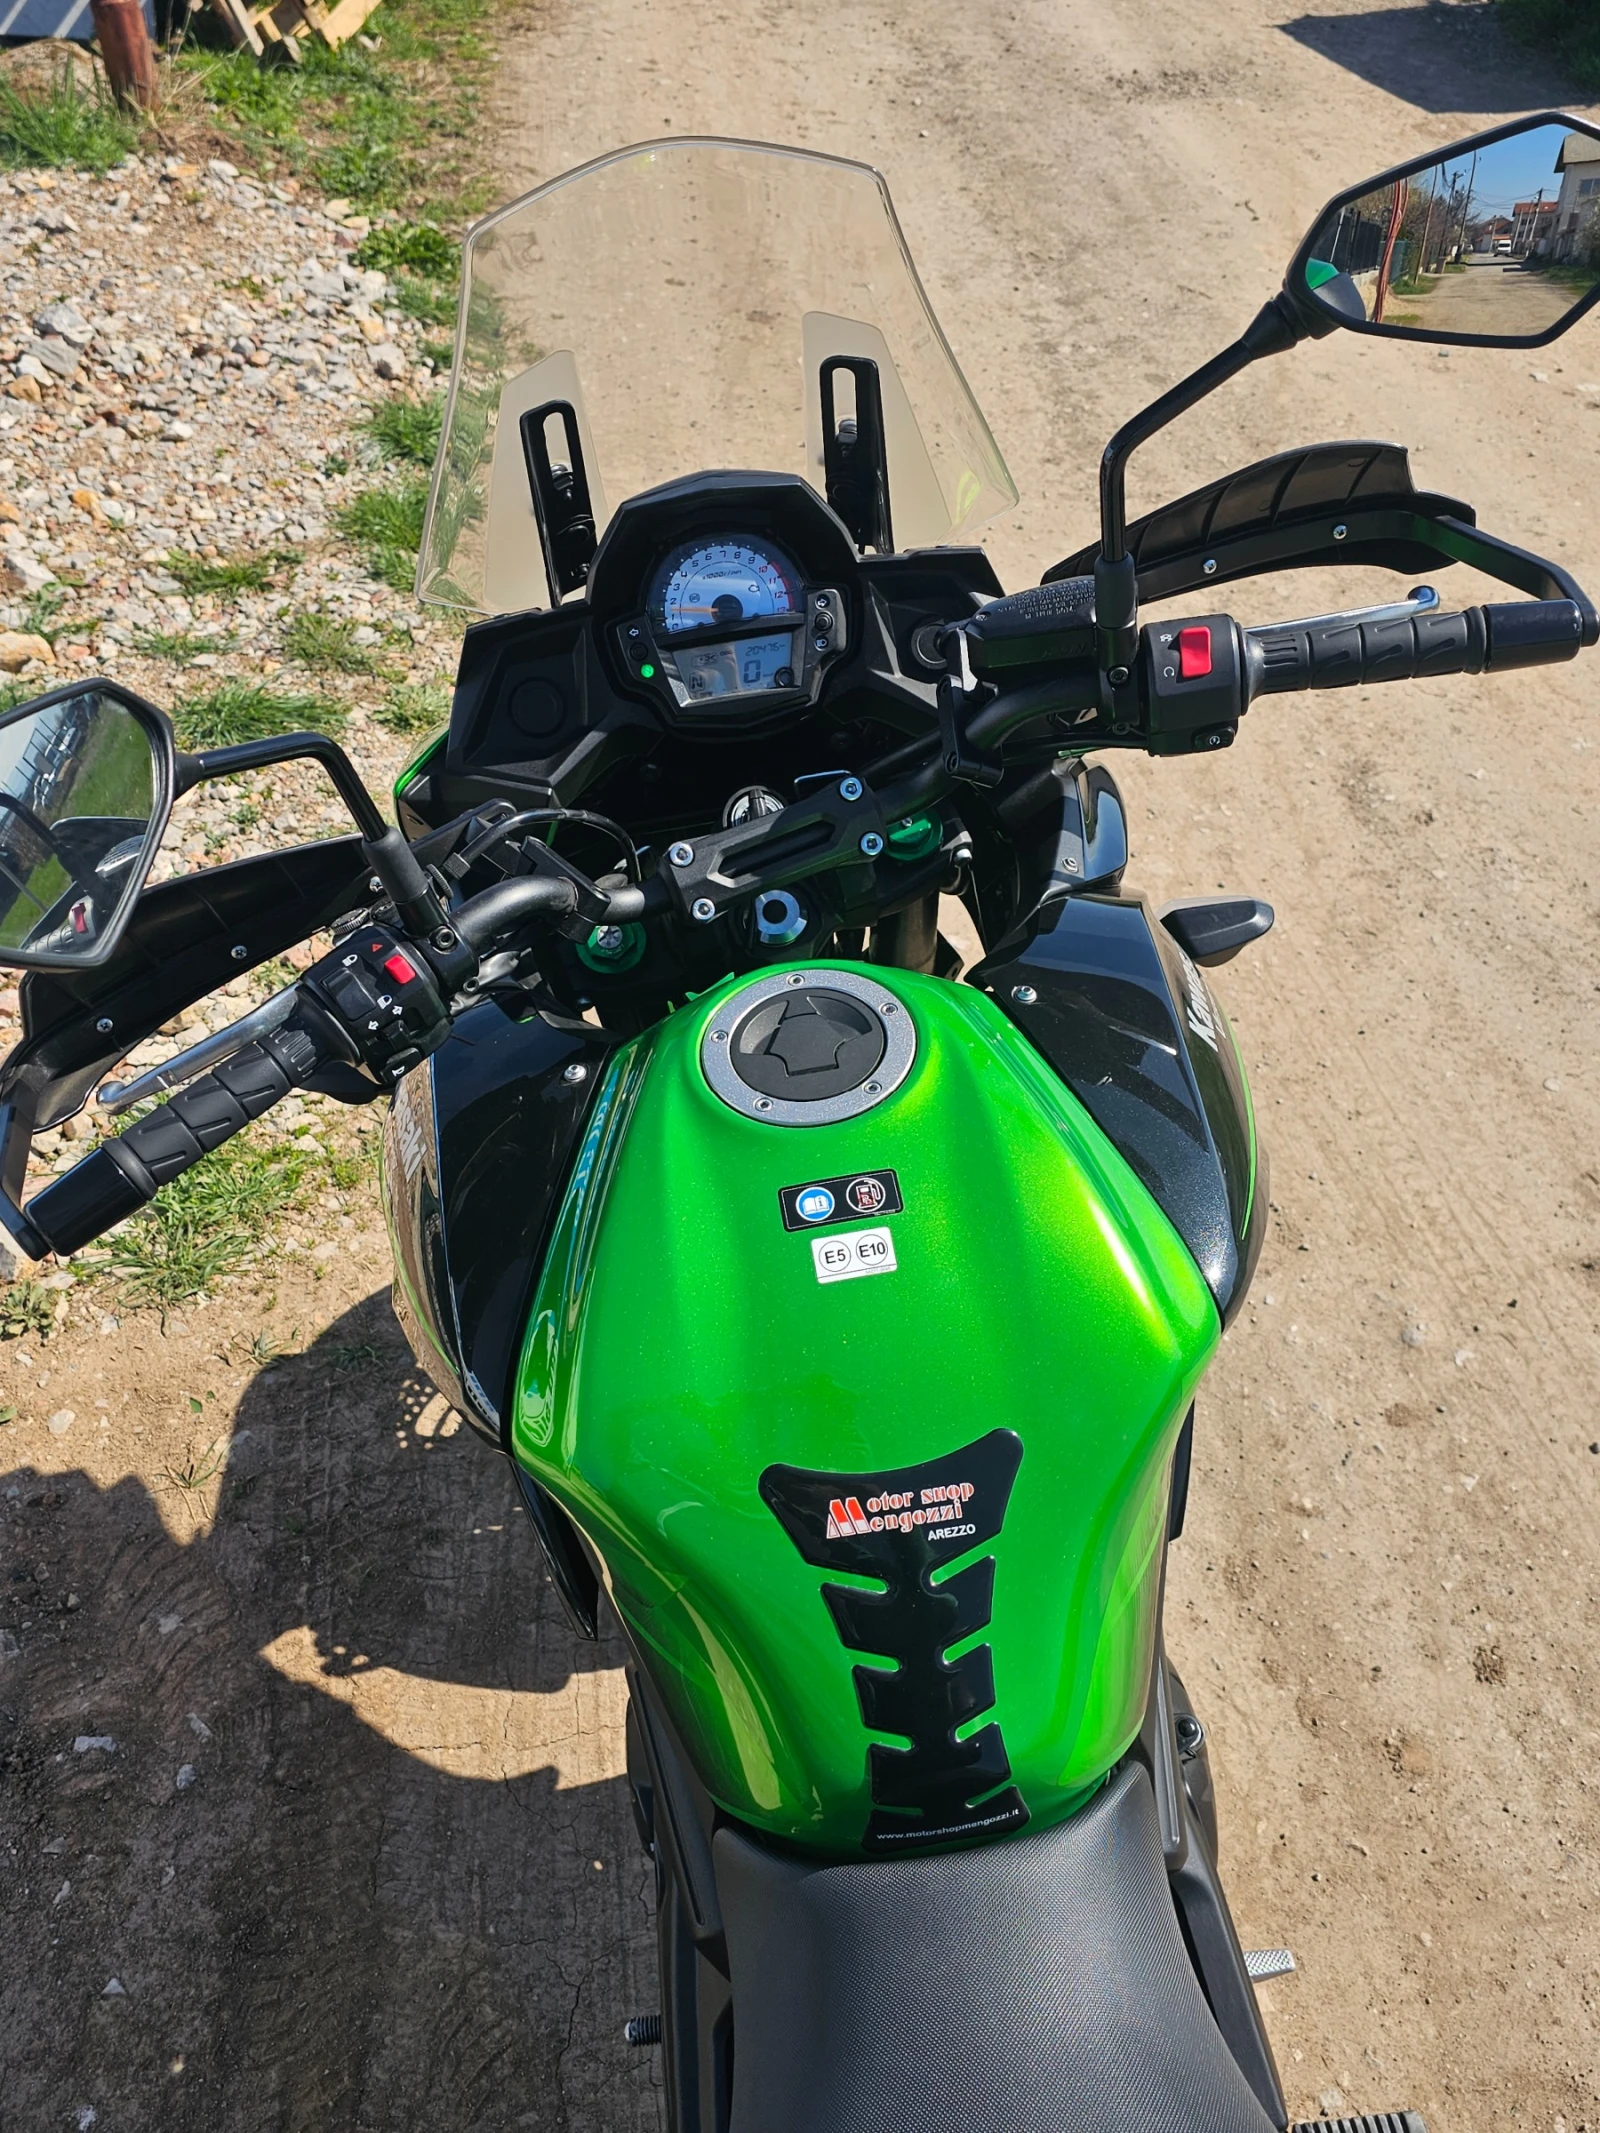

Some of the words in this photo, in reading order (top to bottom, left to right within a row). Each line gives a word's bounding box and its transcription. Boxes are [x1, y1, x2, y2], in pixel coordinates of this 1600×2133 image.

[705, 552, 713, 560] 6
[720, 550, 727, 558] 7
[734, 551, 742, 559] 8
[748, 556, 755, 564] 9
[673, 583, 680, 591] 3
[743, 659, 762, 684] 0
[824, 1248, 847, 1265] E5
[859, 1242, 886, 1258] E10
[928, 1523, 976, 1541] AREZZO
[876, 1808, 1020, 1840] www.motorshopmengozzi.it
